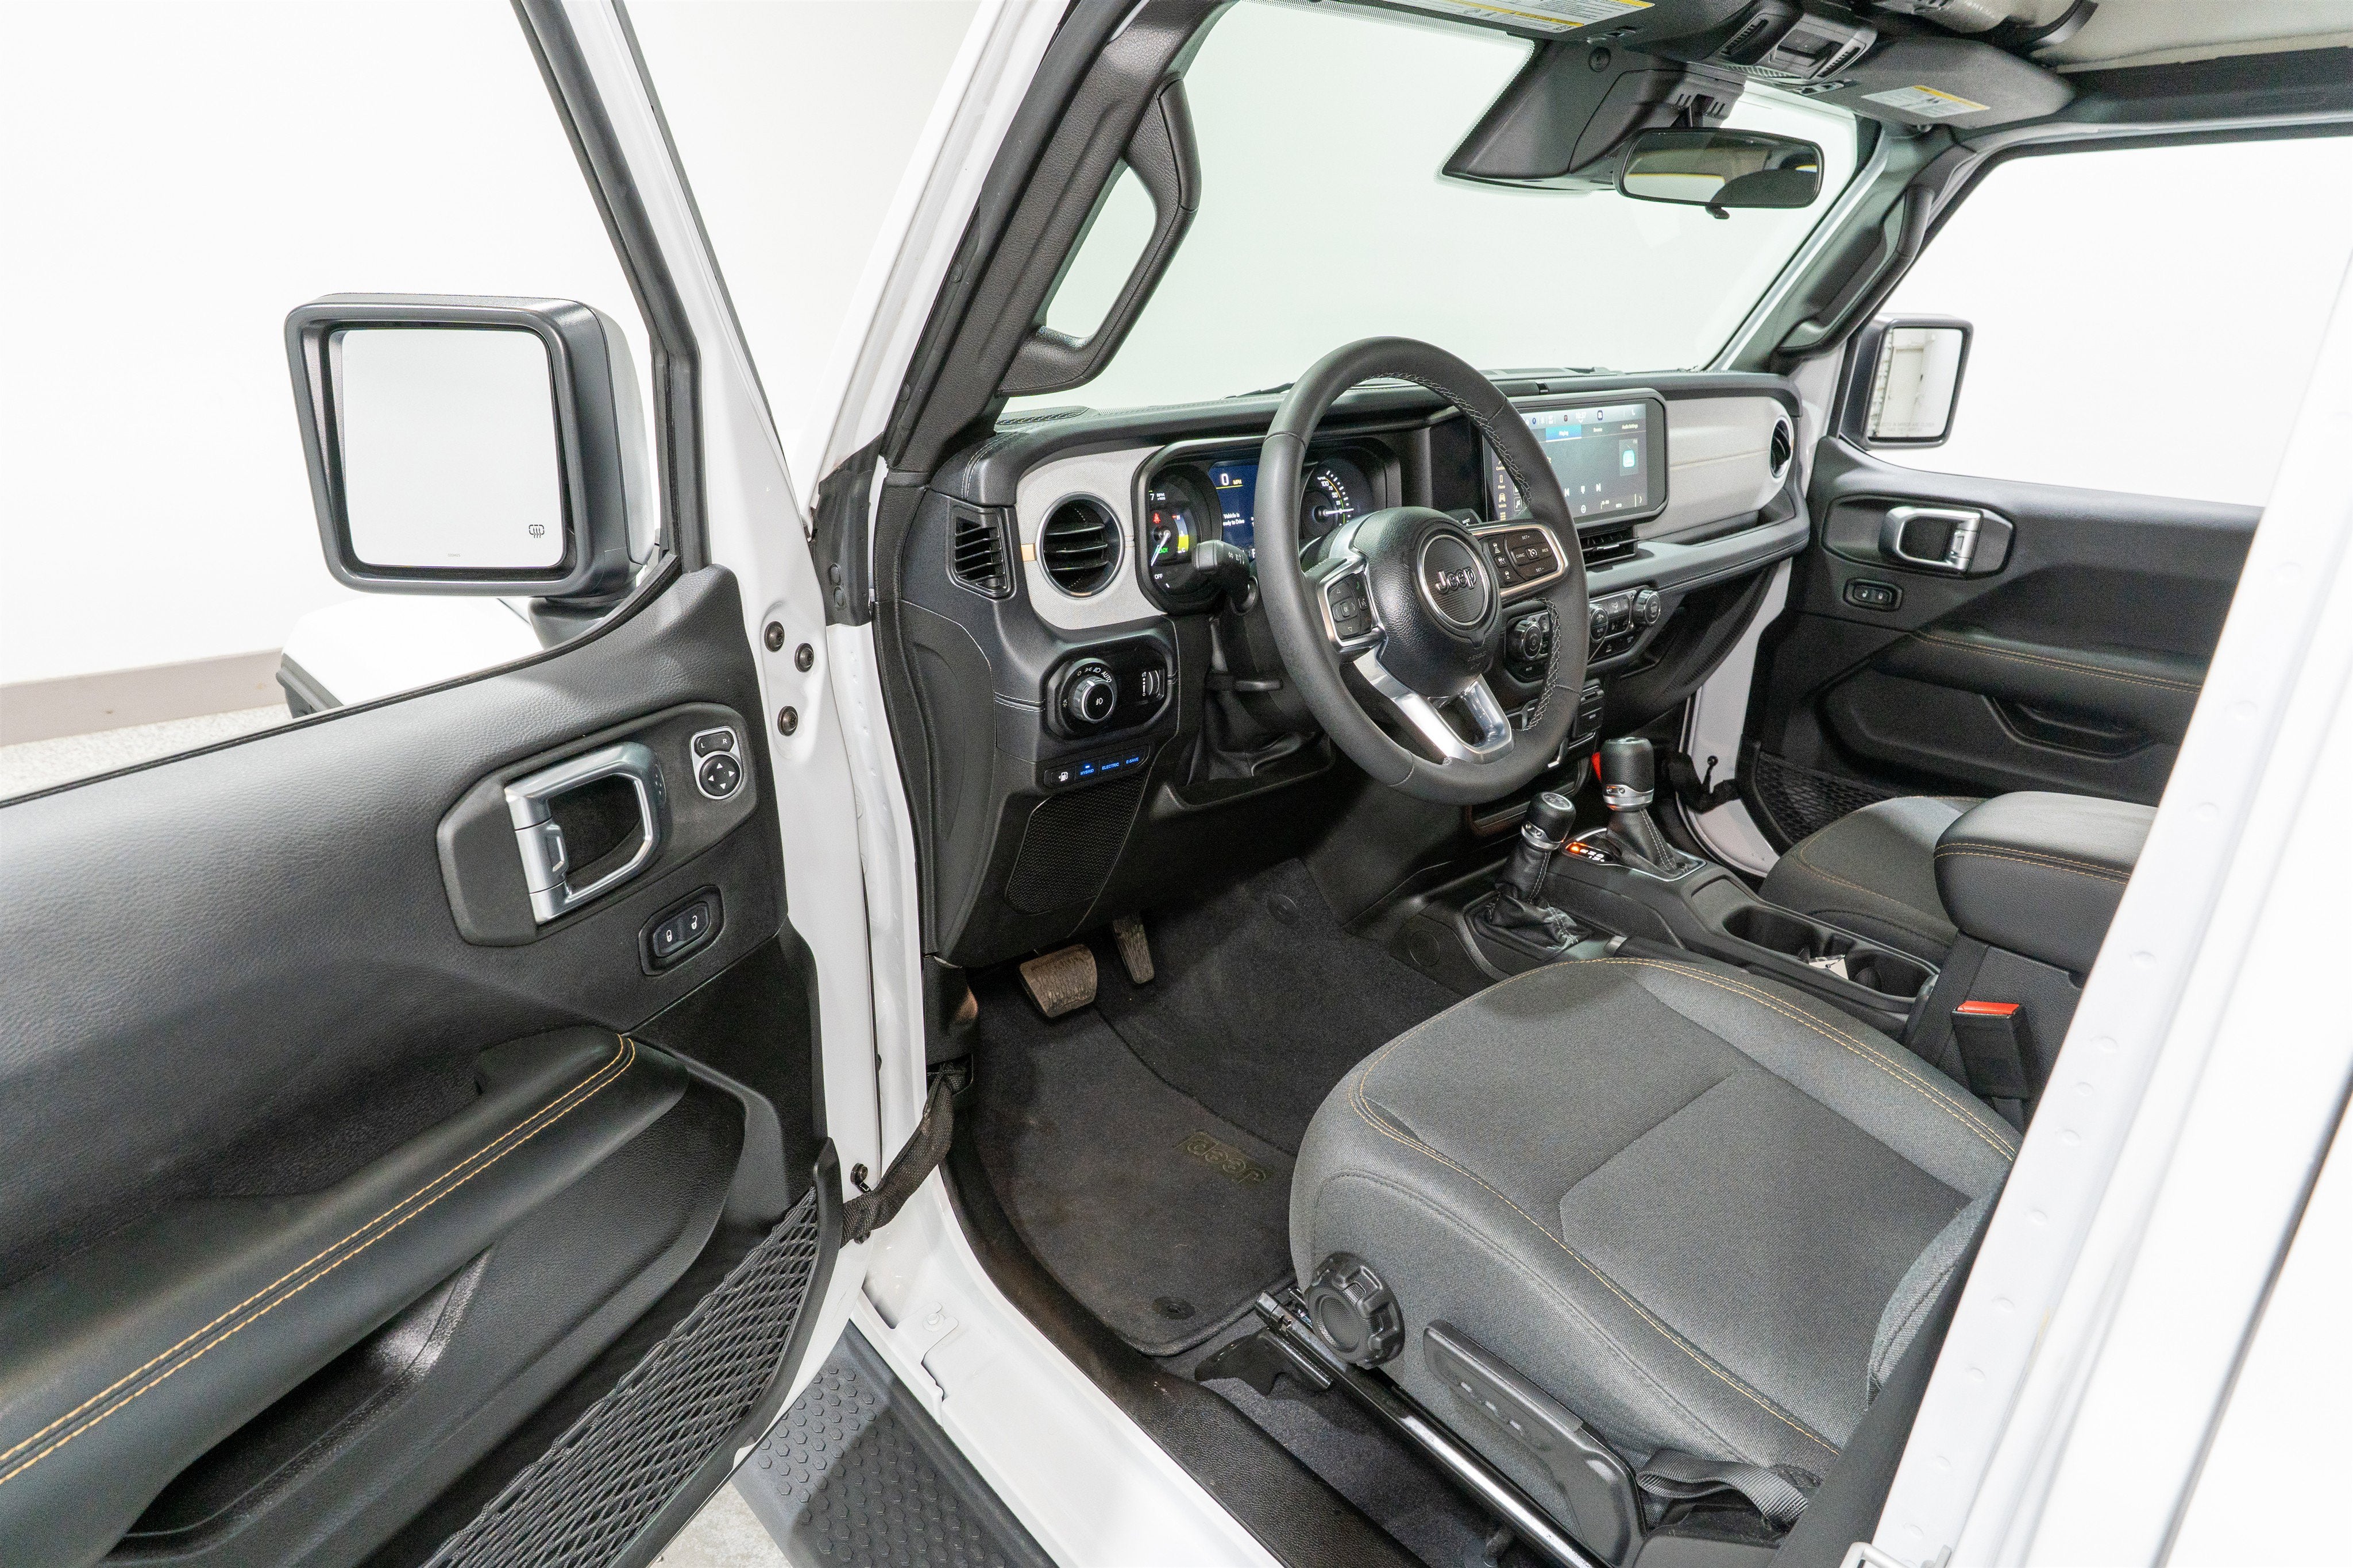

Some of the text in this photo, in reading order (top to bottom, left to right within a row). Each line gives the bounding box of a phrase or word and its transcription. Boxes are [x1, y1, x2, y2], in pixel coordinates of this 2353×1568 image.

[1221, 473, 1229, 486] 0
[1150, 493, 1155, 501] 7
[1435, 567, 1476, 593] Jeep
[1101, 671, 1112, 683] AUTO
[1102, 762, 1120, 770] ELECTRIC
